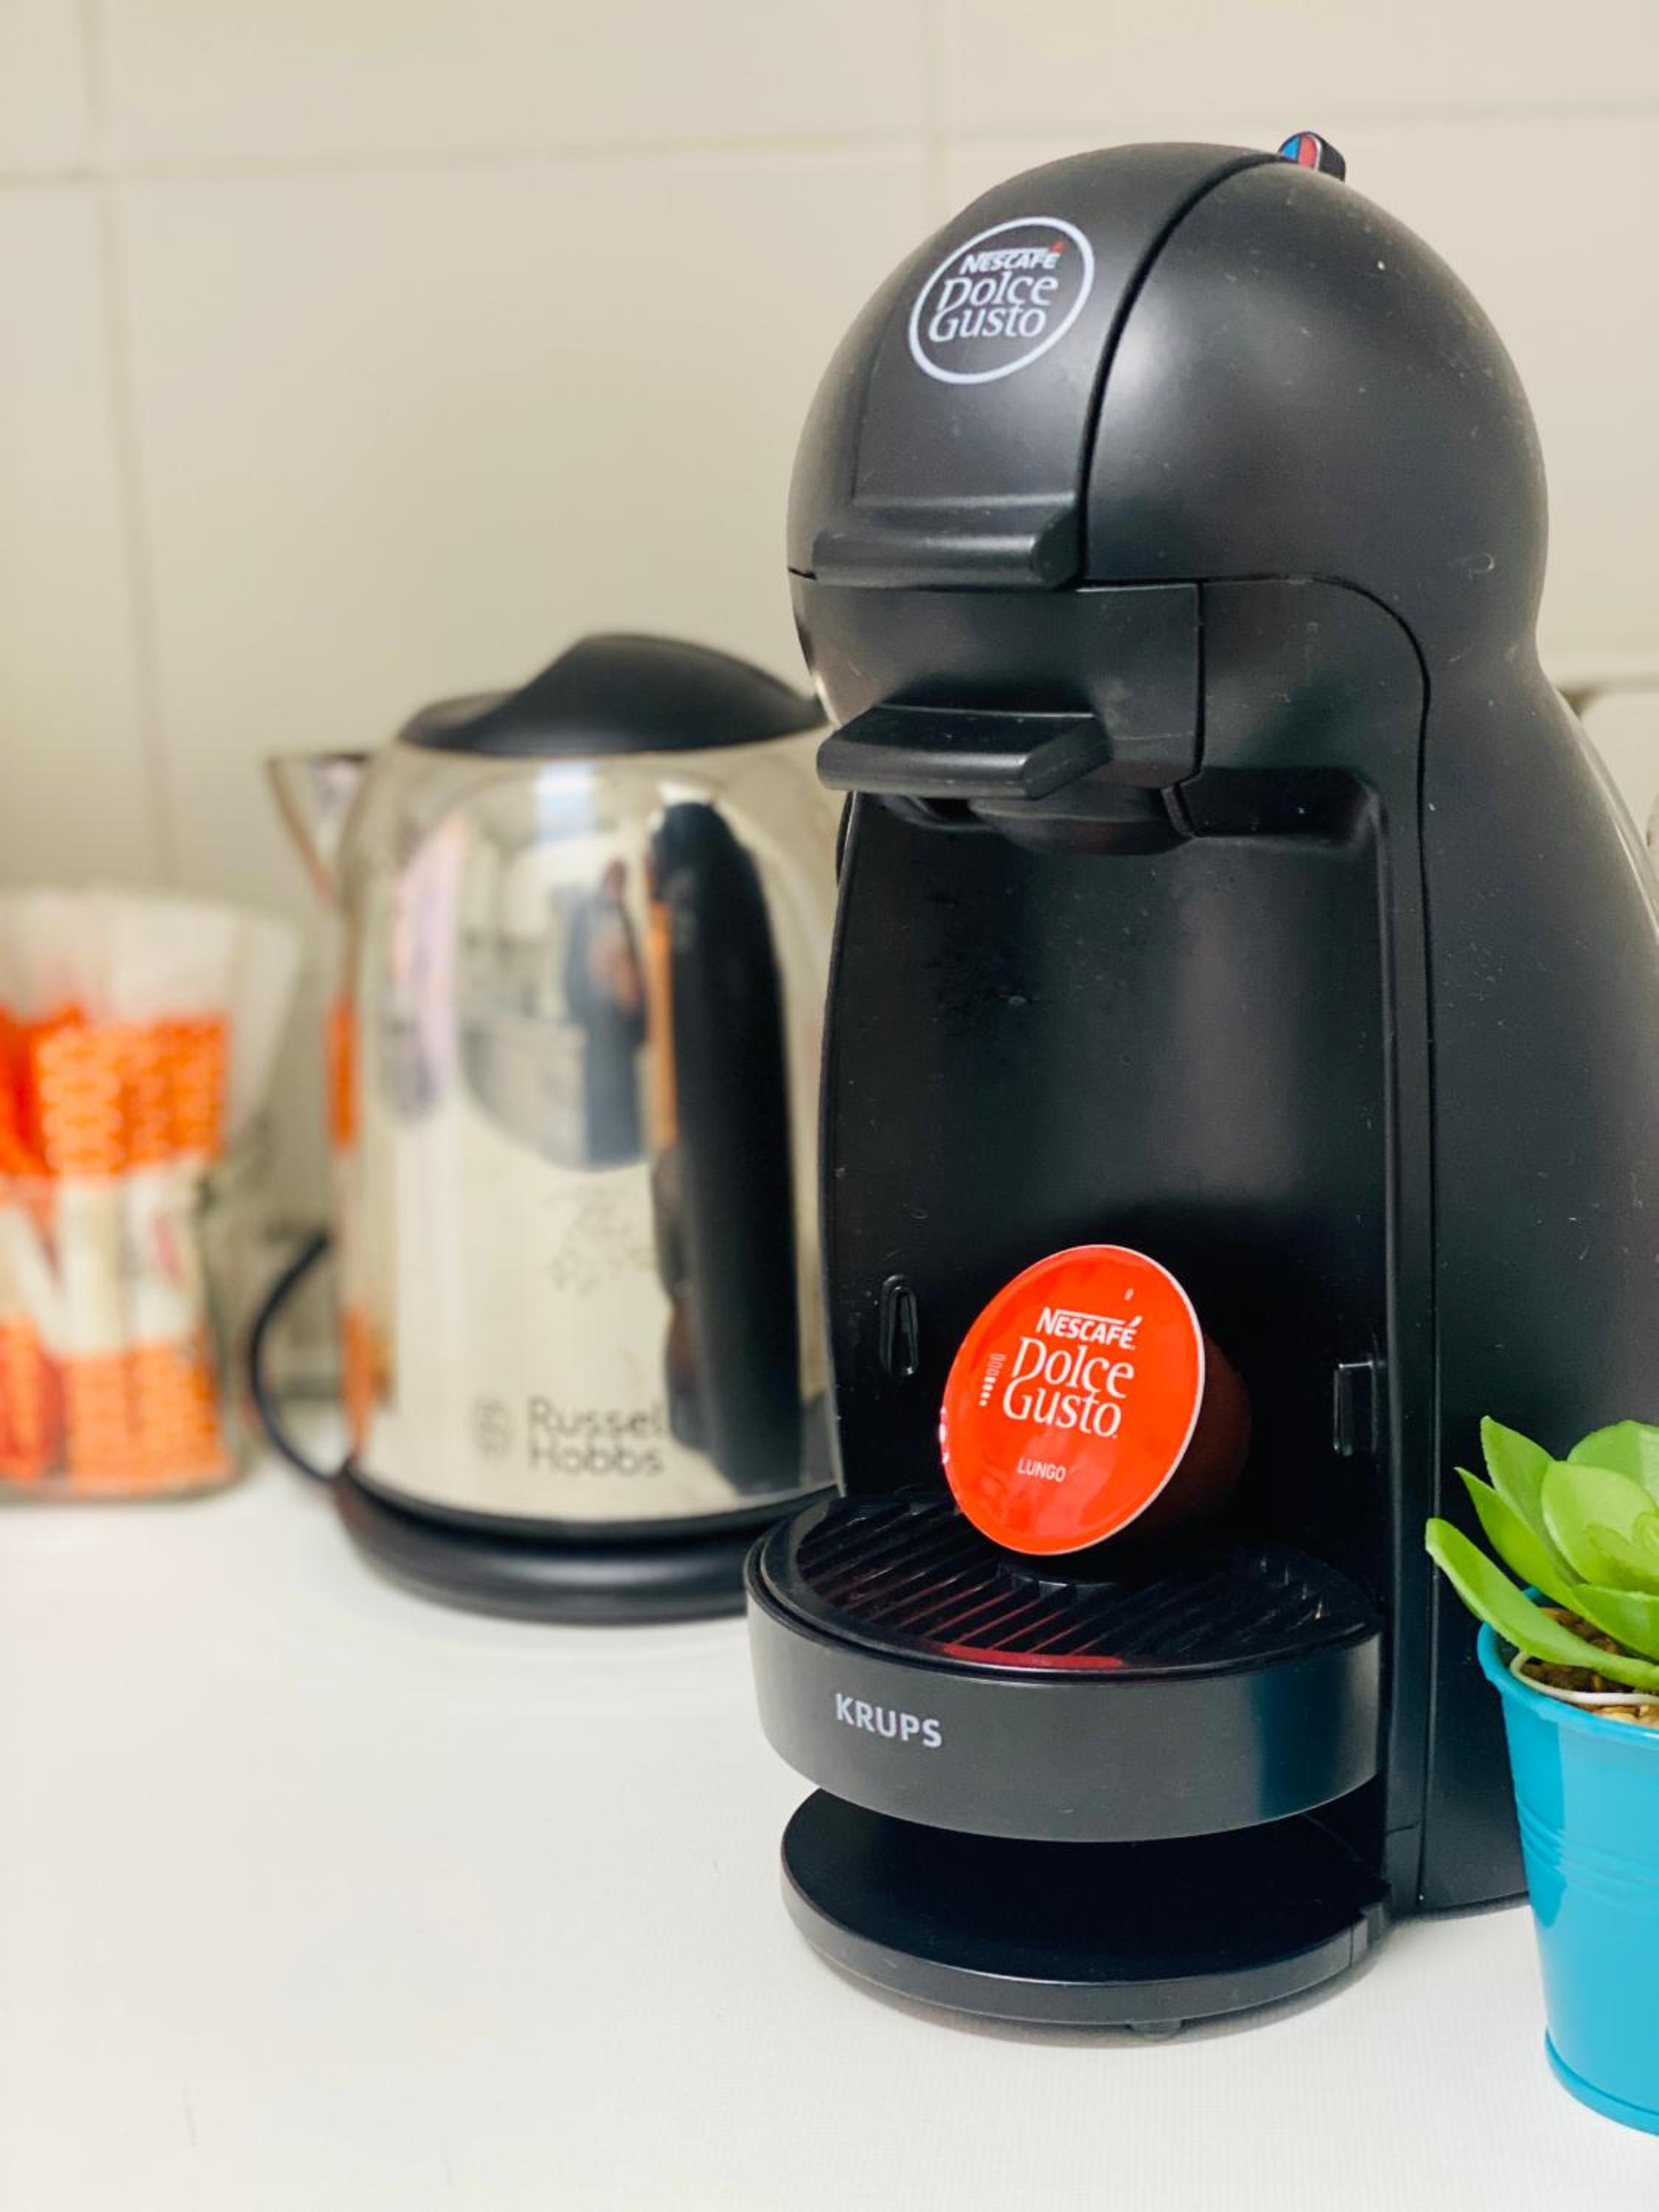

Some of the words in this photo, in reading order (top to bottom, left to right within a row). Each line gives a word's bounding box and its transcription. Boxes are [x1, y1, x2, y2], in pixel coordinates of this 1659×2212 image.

[959, 237, 1065, 275] NESCAFÉ
[937, 271, 1059, 311] Dolce
[928, 302, 1047, 343] Gusto
[1035, 1306, 1143, 1350] NESCAFÉ
[1011, 1336, 1135, 1399] Dolce
[526, 1394, 664, 1439] Russel
[1003, 1377, 1123, 1439] Gusto
[526, 1436, 666, 1477] Hobbs
[1017, 1456, 1067, 1483] LUNGO
[835, 1691, 943, 1749] KRUPS
